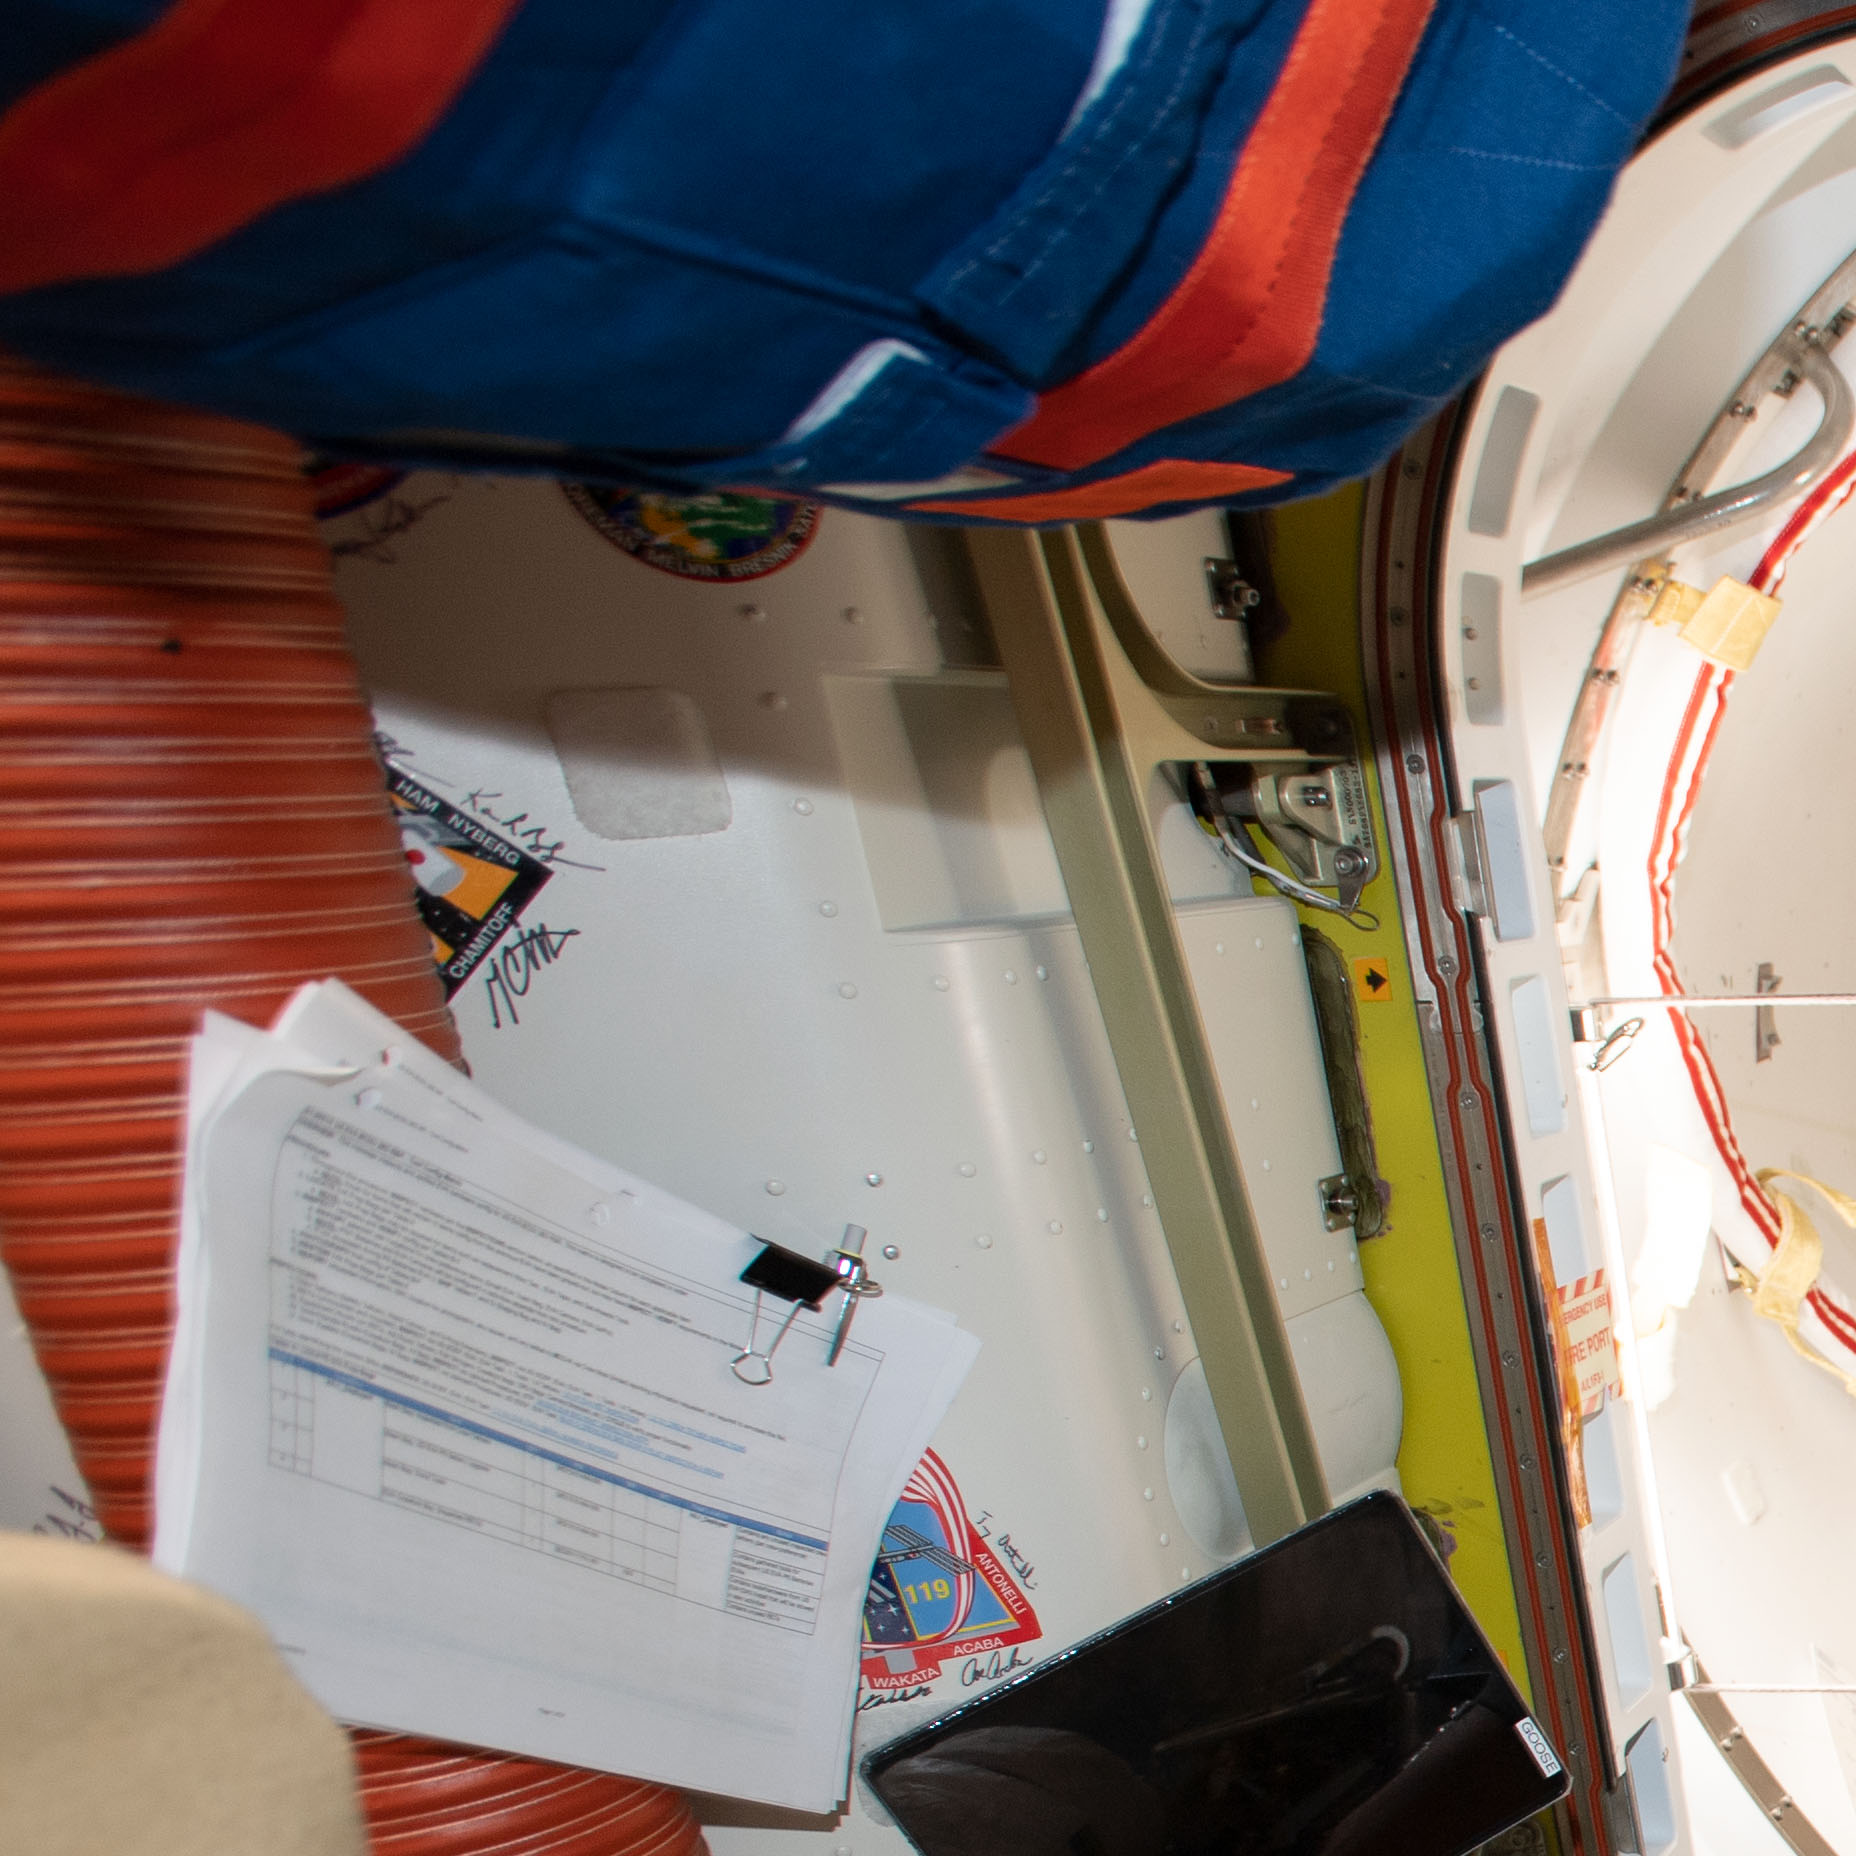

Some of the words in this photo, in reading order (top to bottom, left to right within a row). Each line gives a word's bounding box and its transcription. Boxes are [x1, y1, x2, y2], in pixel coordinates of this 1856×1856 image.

[396, 779, 439, 814] HAM
[446, 813, 522, 865] NYBERG
[449, 901, 514, 979] CHAMITOFF
[1587, 1326, 1611, 1357] PORT
[904, 1577, 951, 1605] 119
[975, 1551, 1028, 1616] ANTONELLI
[953, 1636, 1005, 1657] ACABA
[873, 1666, 941, 1688] WAKATA
[1521, 1721, 1559, 1774] GOOSE
